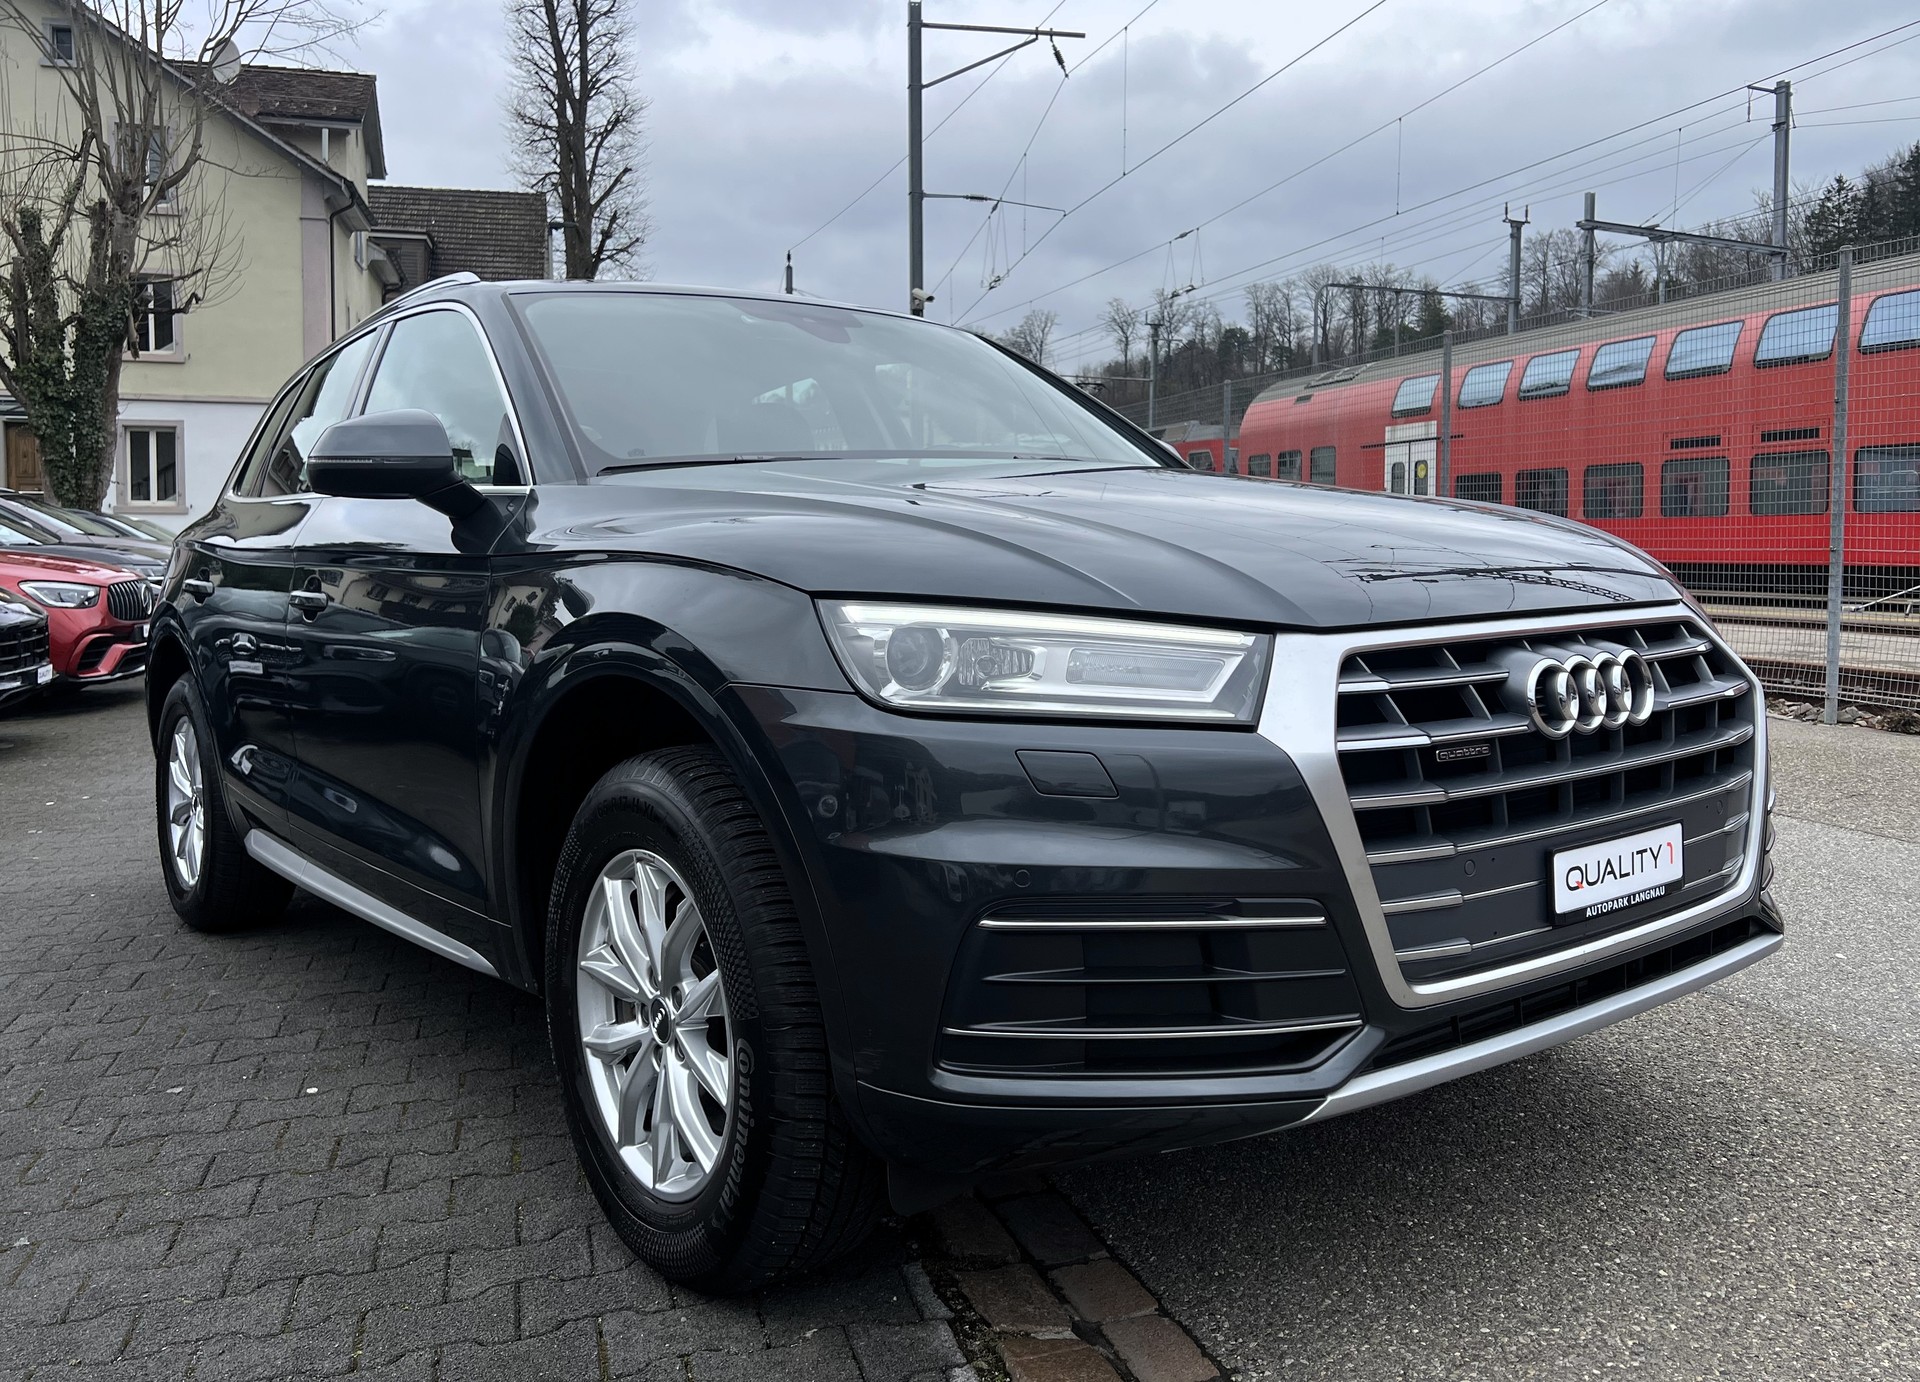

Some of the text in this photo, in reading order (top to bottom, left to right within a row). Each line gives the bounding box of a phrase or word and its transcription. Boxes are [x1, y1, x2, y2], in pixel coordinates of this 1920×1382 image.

[1439, 746, 1490, 760] quattro
[1585, 885, 1666, 918] AUTOPARK LANGNAU
[718, 1037, 755, 1221] Continental
